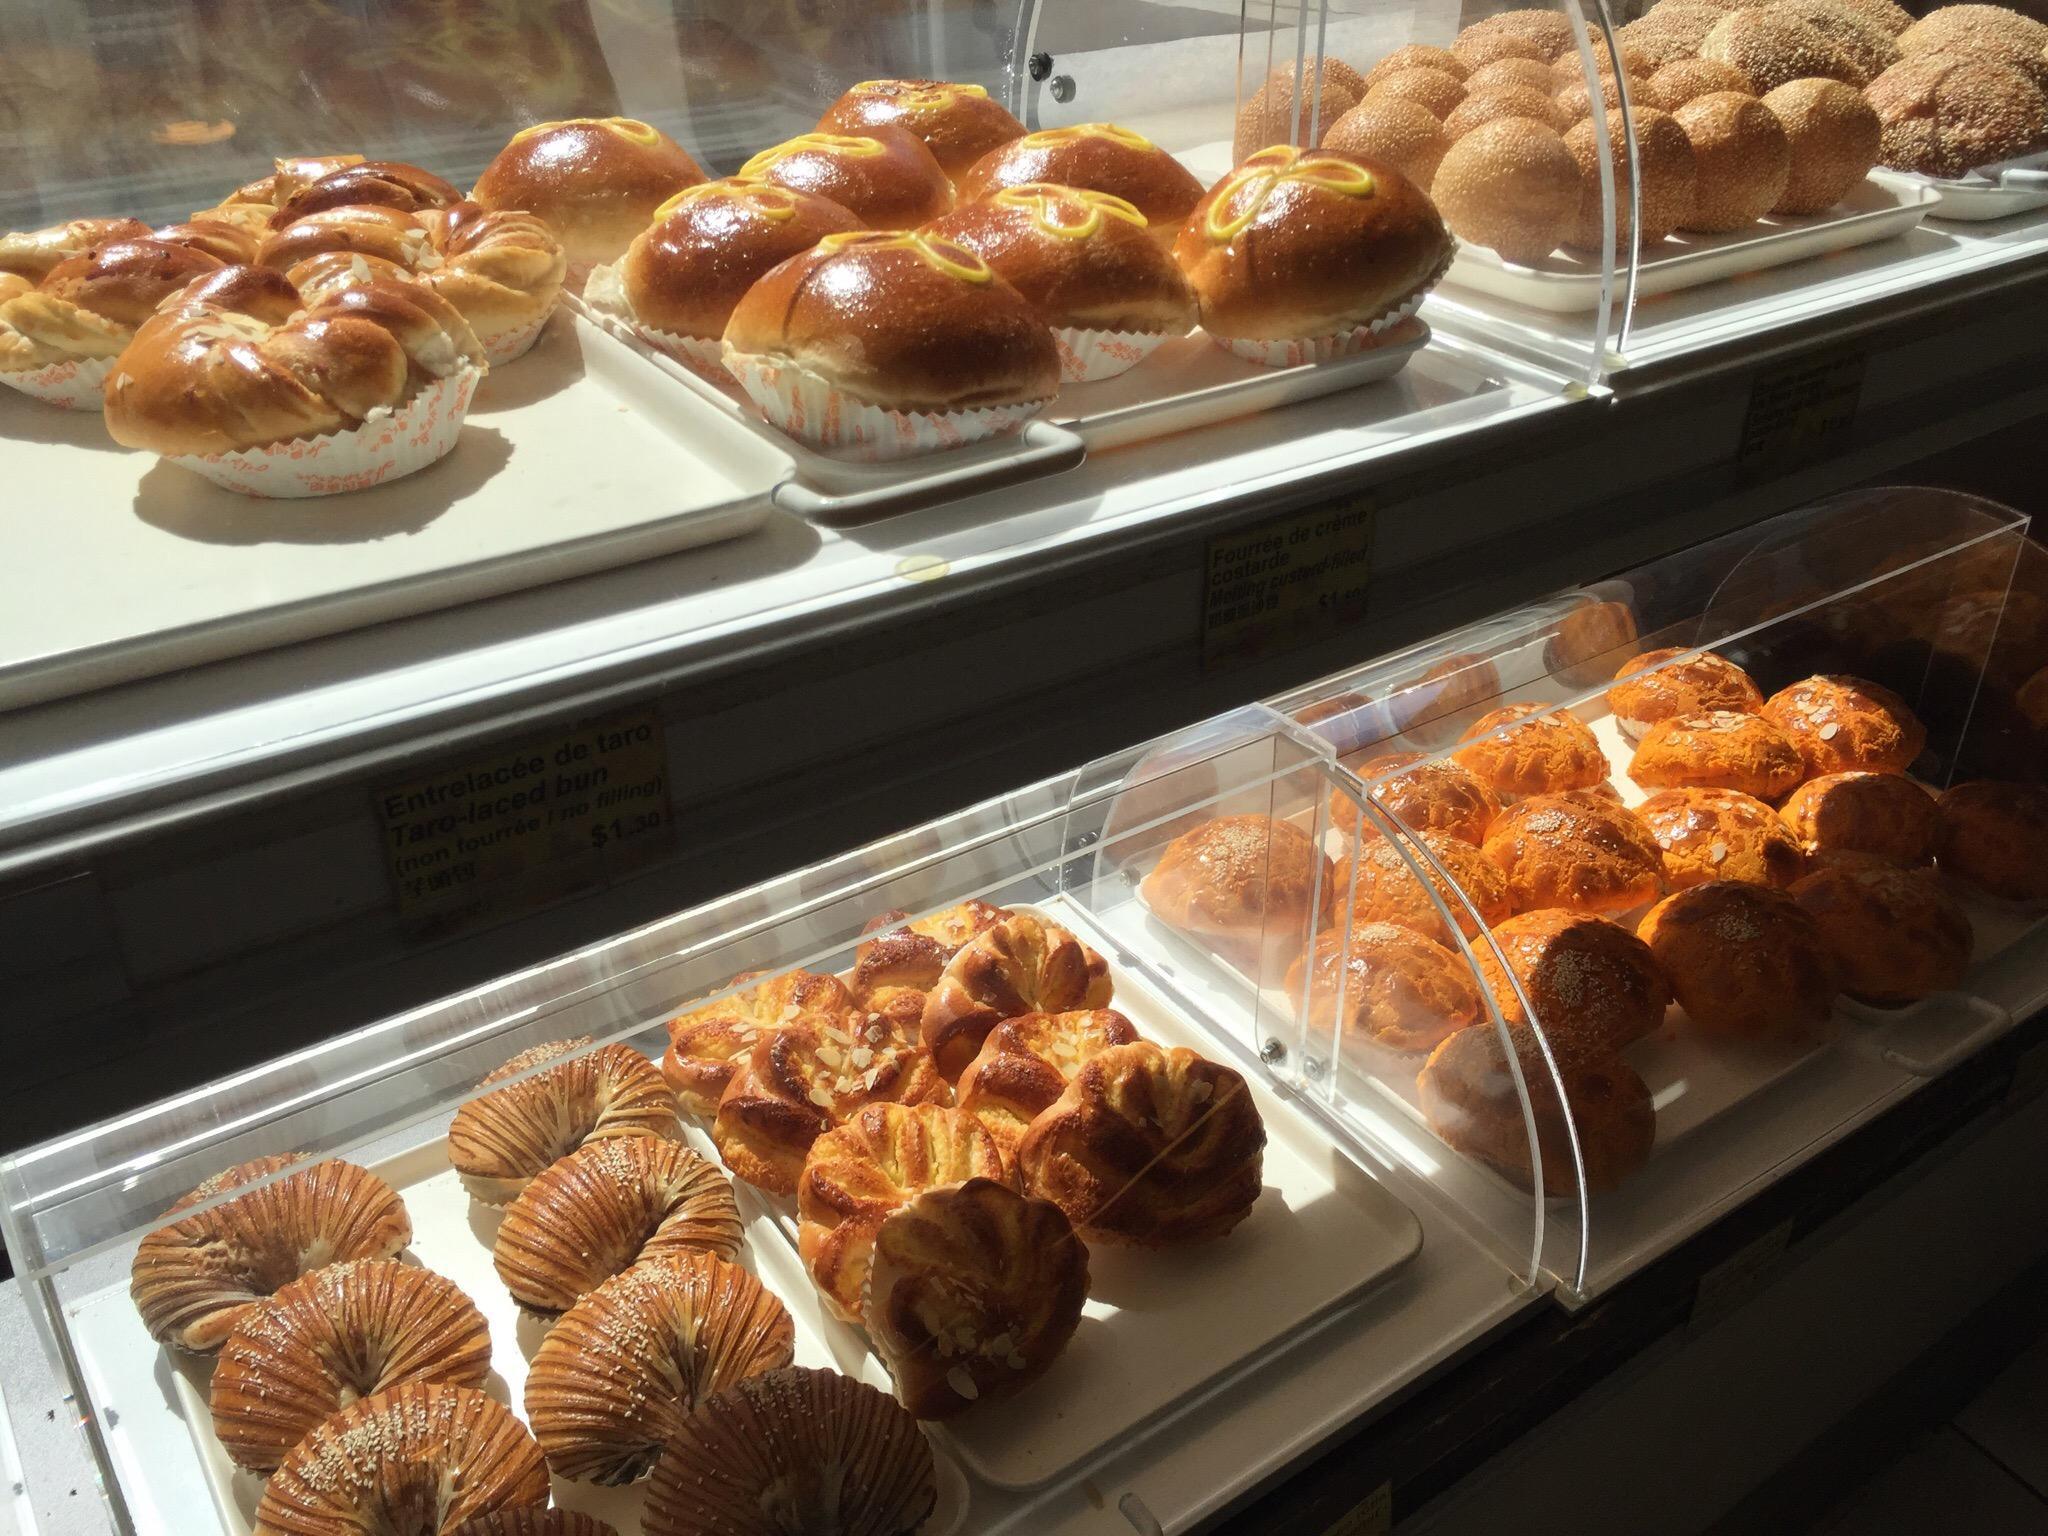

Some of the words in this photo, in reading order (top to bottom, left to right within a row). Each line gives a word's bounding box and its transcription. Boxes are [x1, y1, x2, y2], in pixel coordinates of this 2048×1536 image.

[1289, 526, 1310, 546] de
[384, 755, 545, 820] Entrelacée
[554, 741, 588, 767] de
[596, 723, 652, 754] taro
[391, 778, 546, 848] Taro-laced
[556, 766, 608, 798] bun
[395, 846, 451, 878] (non
[559, 802, 591, 822] no
